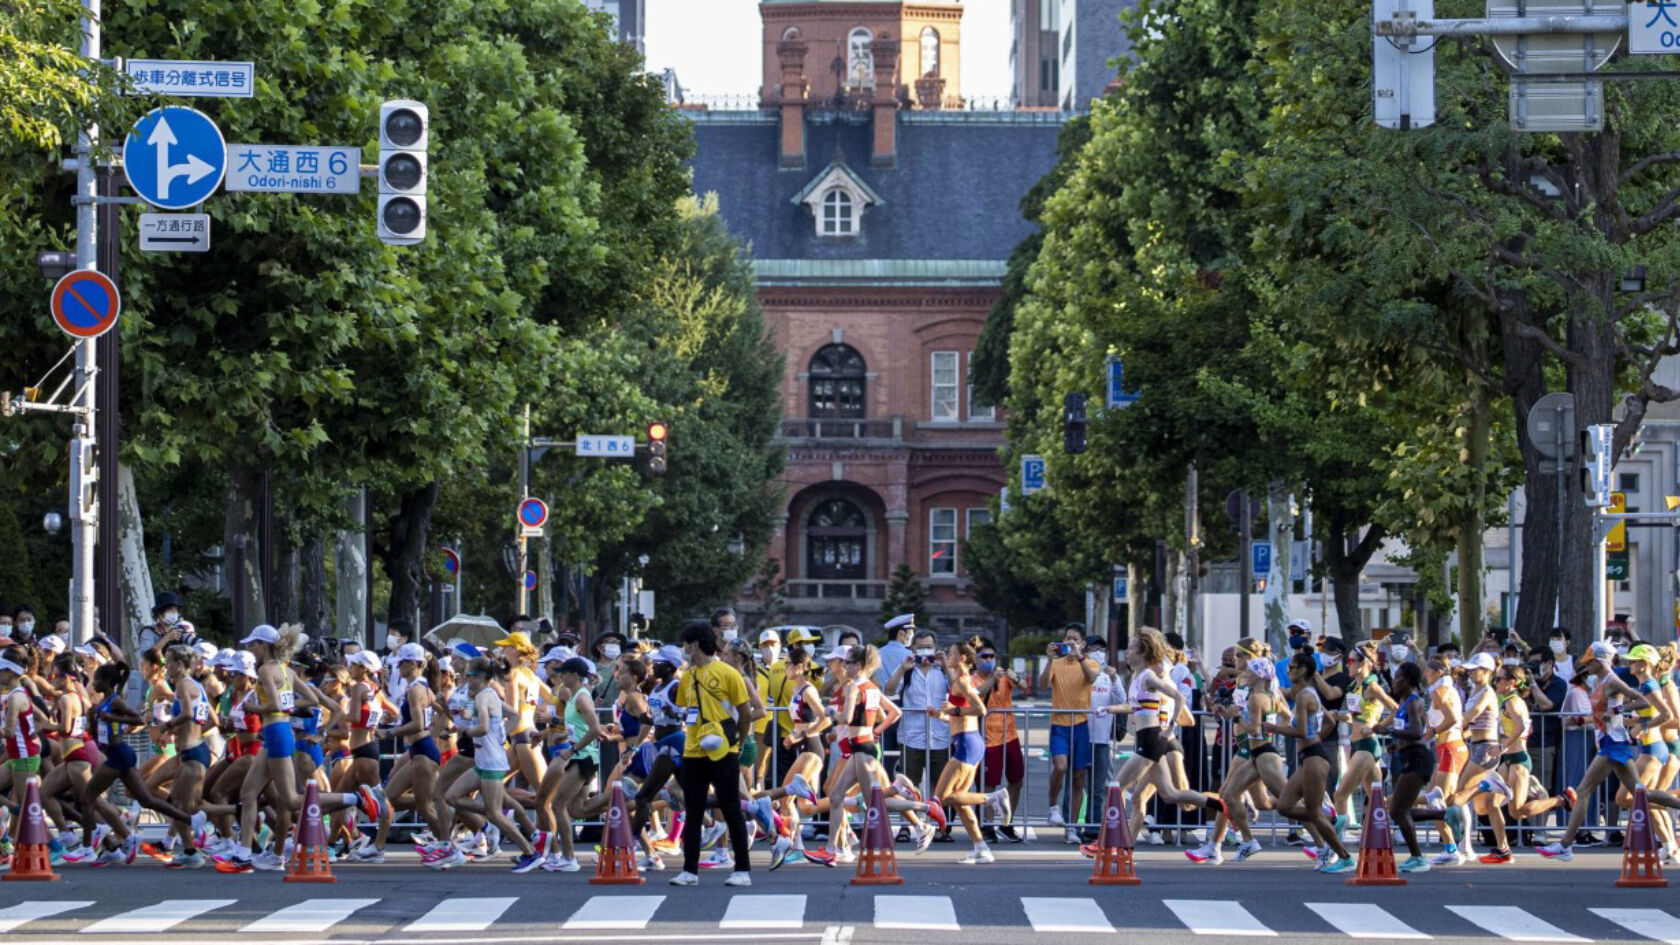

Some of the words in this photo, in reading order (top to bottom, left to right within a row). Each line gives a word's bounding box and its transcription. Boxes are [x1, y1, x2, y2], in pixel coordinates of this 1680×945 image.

[133, 70, 246, 87] 歩車分離式信号
[248, 174, 322, 188] Odori-nishi
[326, 177, 336, 189] 6
[144, 219, 205, 232] 一方通行路
